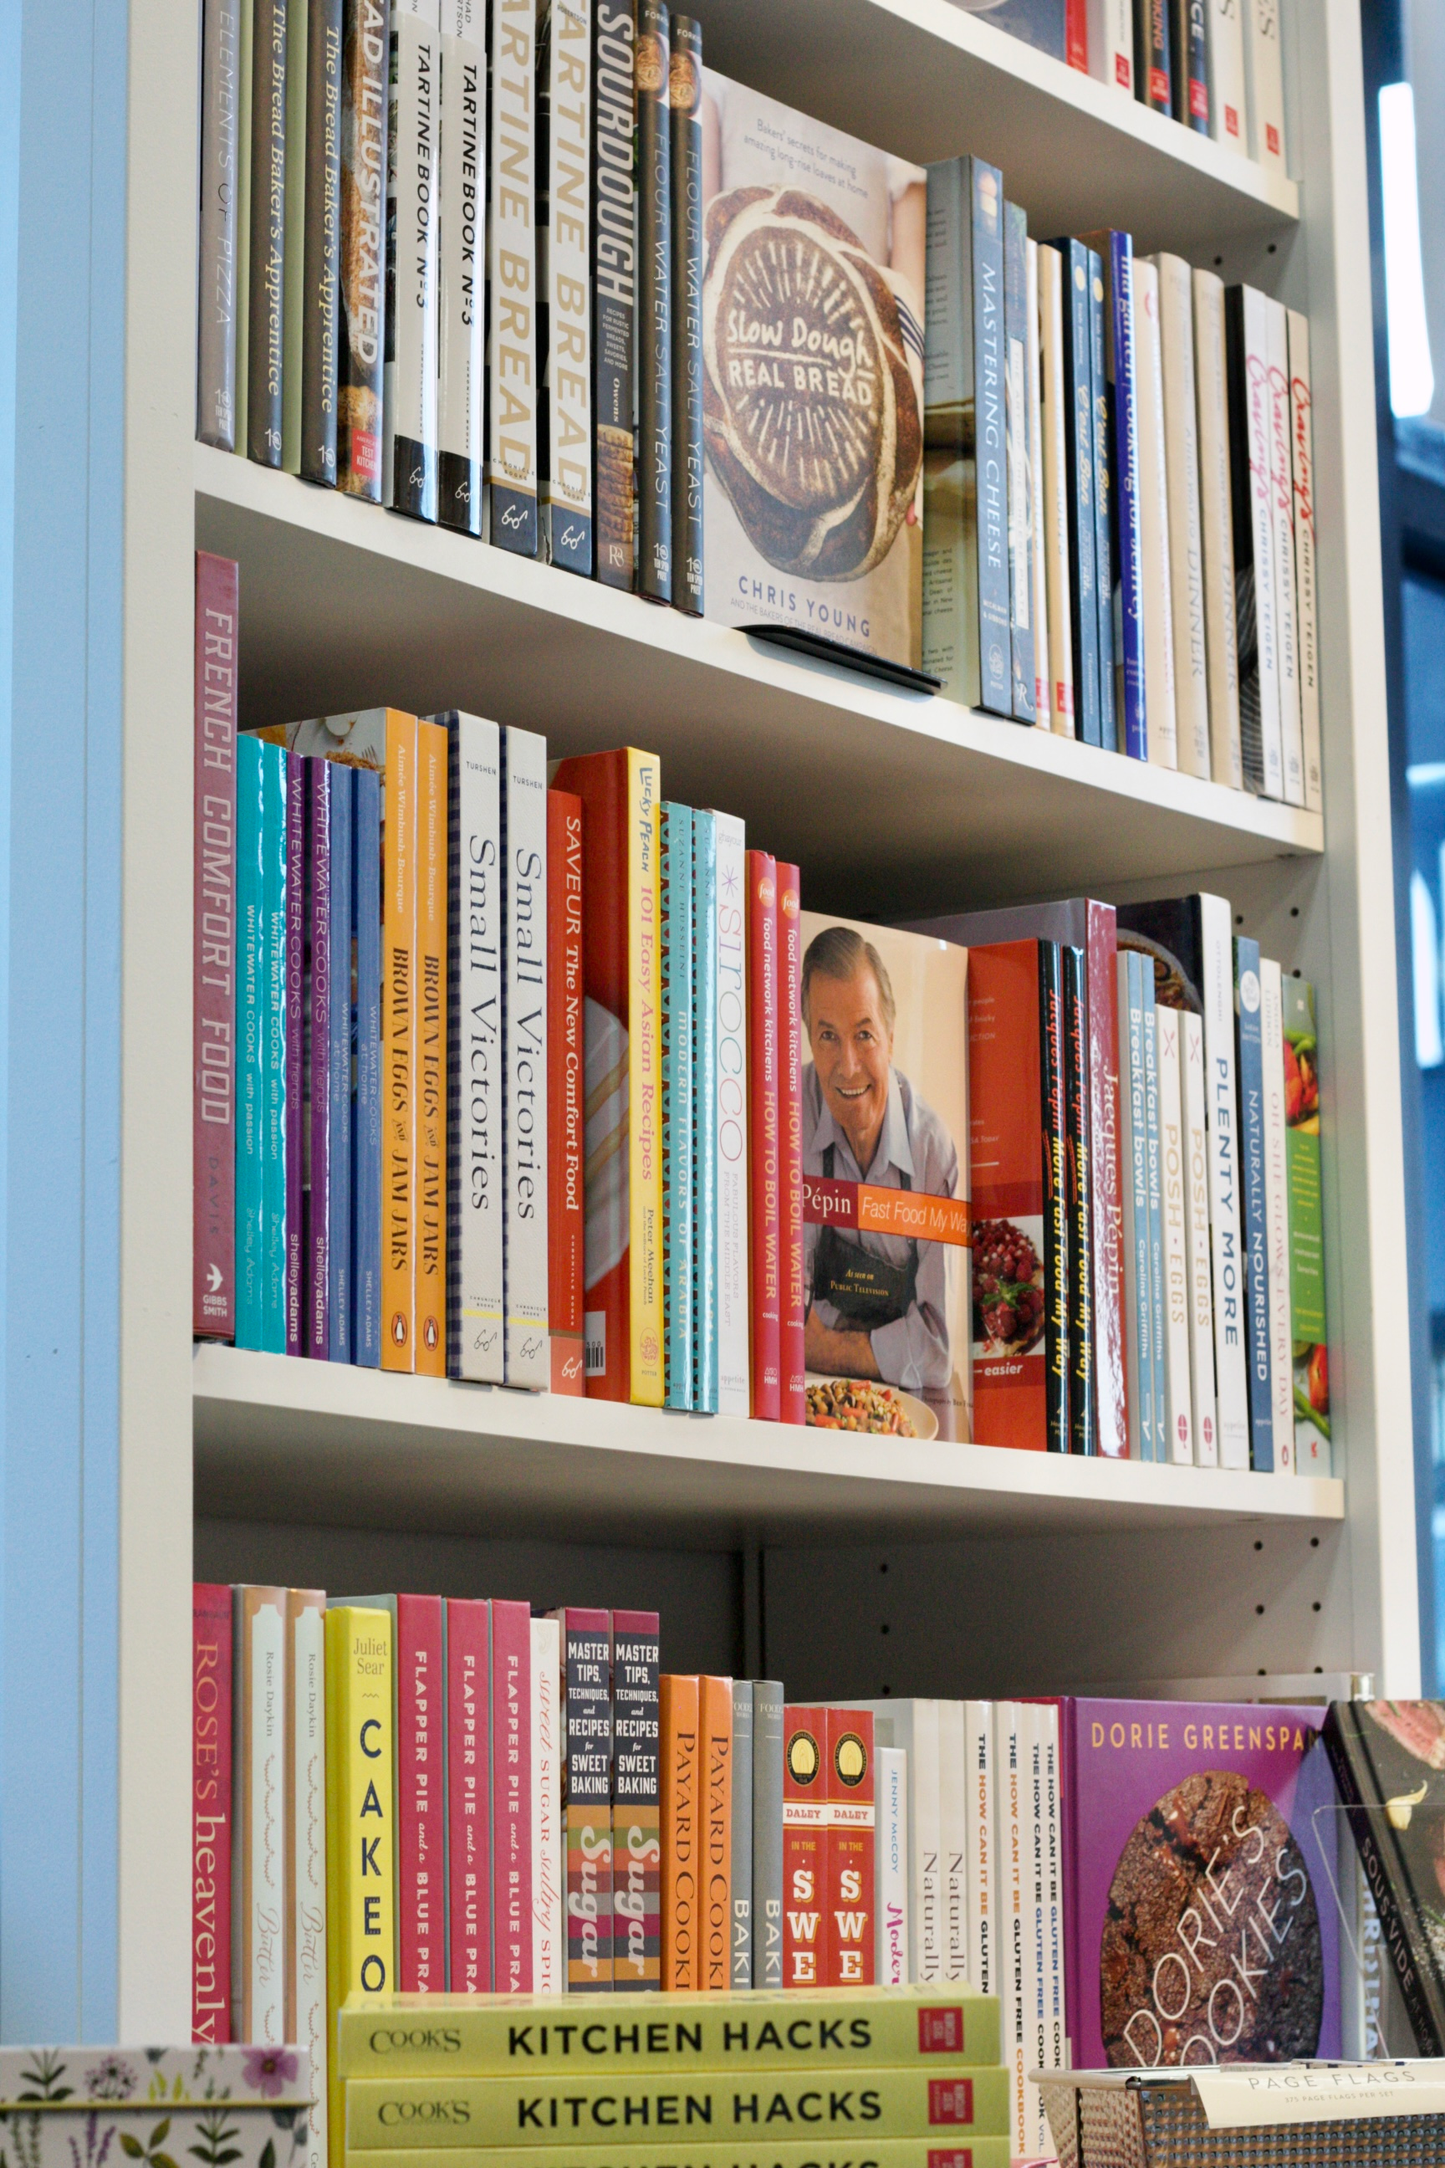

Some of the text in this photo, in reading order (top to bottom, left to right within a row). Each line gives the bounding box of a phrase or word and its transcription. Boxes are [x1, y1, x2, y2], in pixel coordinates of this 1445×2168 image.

[216, 10, 236, 324] ELEMENTS PIZZA
[416, 44, 431, 243] TARTINE BOOK
[462, 64, 477, 263] TARTINE BOOK
[597, 4, 634, 305] SOURDOUGH
[744, 136, 869, 198] amazing long-rise loaves at home
[787, 136, 815, 157] secrets
[816, 146, 828, 161] for
[829, 155, 857, 180] making
[265, 4, 286, 396] The Bread Baker's Apprentice
[318, 26, 340, 414] The Bread Baker's Apprentice
[356, 76, 383, 364] ILLUSTRATED
[602, 323, 629, 337] FERMENTED
[603, 314, 629, 330] FOR RUSTIC
[604, 348, 627, 363] SAVORIES,
[606, 307, 625, 319] RECIPES
[606, 341, 626, 354] SWEETS,
[654, 132, 668, 514] FLOUR WATER SALT YEAST
[686, 150, 701, 525] FLOUR WATER SALT YEAST
[727, 310, 875, 378] Slow Dough
[499, 248, 531, 480] BREAD
[557, 272, 588, 501] BREAD
[604, 357, 628, 371] AND MORE
[729, 359, 872, 406] REAL BREAD
[981, 262, 1001, 568] MASTERING CHEESE
[739, 575, 871, 637] CHRIS YOUNG
[1301, 528, 1315, 688] CHRISSY TEIGEN
[466, 760, 497, 776] TURSHEN
[513, 774, 543, 790] TURSHEN
[201, 607, 233, 1125] FRENCH COMFORT FOOD
[290, 777, 302, 1019] WHITEWATER COOKS
[244, 904, 256, 1155] WHITEWATER COOKS with passion
[470, 834, 497, 1210] Small Victories
[516, 848, 543, 1219] Small Victories
[565, 815, 581, 1211] SAVEUR The New Comfort Food
[638, 885, 655, 1181] 101 Easy Asian Recipes
[391, 947, 409, 1272] BROWN EGGS JAM JARS
[423, 955, 439, 1276] BROWN EGGS JAM JARS
[763, 917, 776, 1300] food network kitchens HOW TO BOIL WATER
[1130, 1008, 1146, 1207] Breakfast bowls
[802, 1183, 948, 1232] Pépin Fast Food My
[1216, 1058, 1238, 1346] PLENTY MORE
[1248, 1090, 1268, 1381] NATURALLY NOURISHED
[203, 1294, 227, 1307] GIBBS
[290, 1233, 300, 1342] shelleyadams
[647, 1207, 655, 1304] Peter Meehan
[203, 1305, 227, 1317] SMITH
[984, 1362, 1023, 1377] easier
[353, 1638, 388, 1656] Juliet
[357, 1658, 385, 1675] Sear
[568, 1642, 609, 1661] MASTER
[569, 1687, 609, 1702] TECHNIQUES,
[577, 1664, 602, 1683] TIPS,
[195, 1640, 219, 1800] ROSE'S
[569, 1719, 609, 1737] RECIPES
[583, 1706, 595, 1715] and
[585, 1741, 594, 1752] for
[1091, 1722, 1318, 1751] DORIE GREENSPAN
[415, 1651, 429, 1935] FLAPPER PIE and BLUE
[571, 1755, 607, 1772] SWEET
[571, 1777, 608, 1794] BAKING
[676, 1732, 695, 1863] PAYARD
[786, 1809, 821, 1820] DALEY
[833, 1809, 868, 1820] DALEY
[192, 1812, 226, 2044] heavenly
[568, 1825, 611, 1978] Sugar
[1009, 1733, 1026, 2154] THE HOW CAN IT BE GLUTEN FREE COOKBOOK
[369, 2019, 872, 2056] COOK'S KITCHEN HACKS
[1248, 2070, 1416, 2091] PAGE FLAGS
[378, 2091, 882, 2128] COOK'S KITCHEN HACKS
